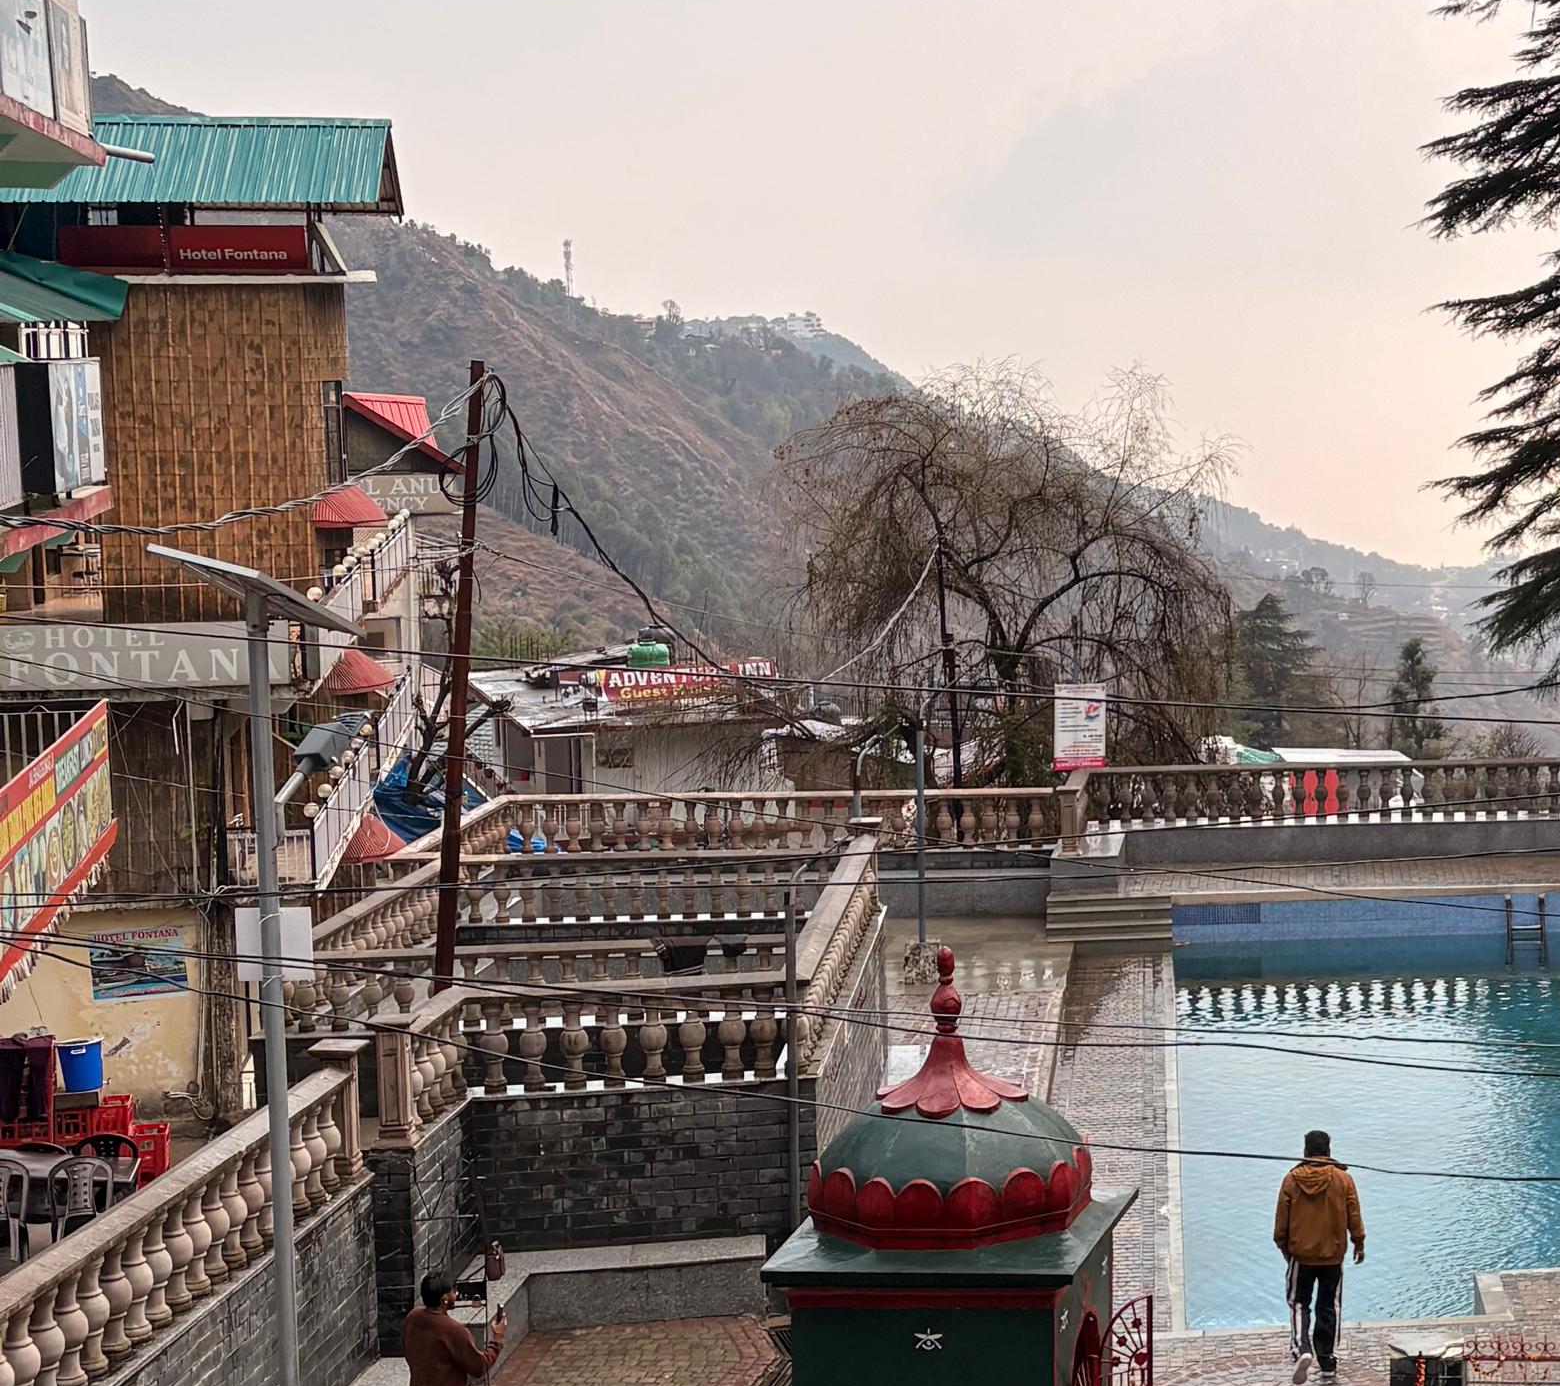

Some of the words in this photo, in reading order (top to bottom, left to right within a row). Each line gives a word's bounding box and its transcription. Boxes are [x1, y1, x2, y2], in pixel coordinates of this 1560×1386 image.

[179, 248, 222, 260] Hotel
[224, 248, 288, 260] Fontana
[44, 627, 166, 649] HOTEL
[619, 686, 668, 699] Guest
[94, 932, 128, 942] HOTEL
[131, 929, 178, 939] FONTANA
